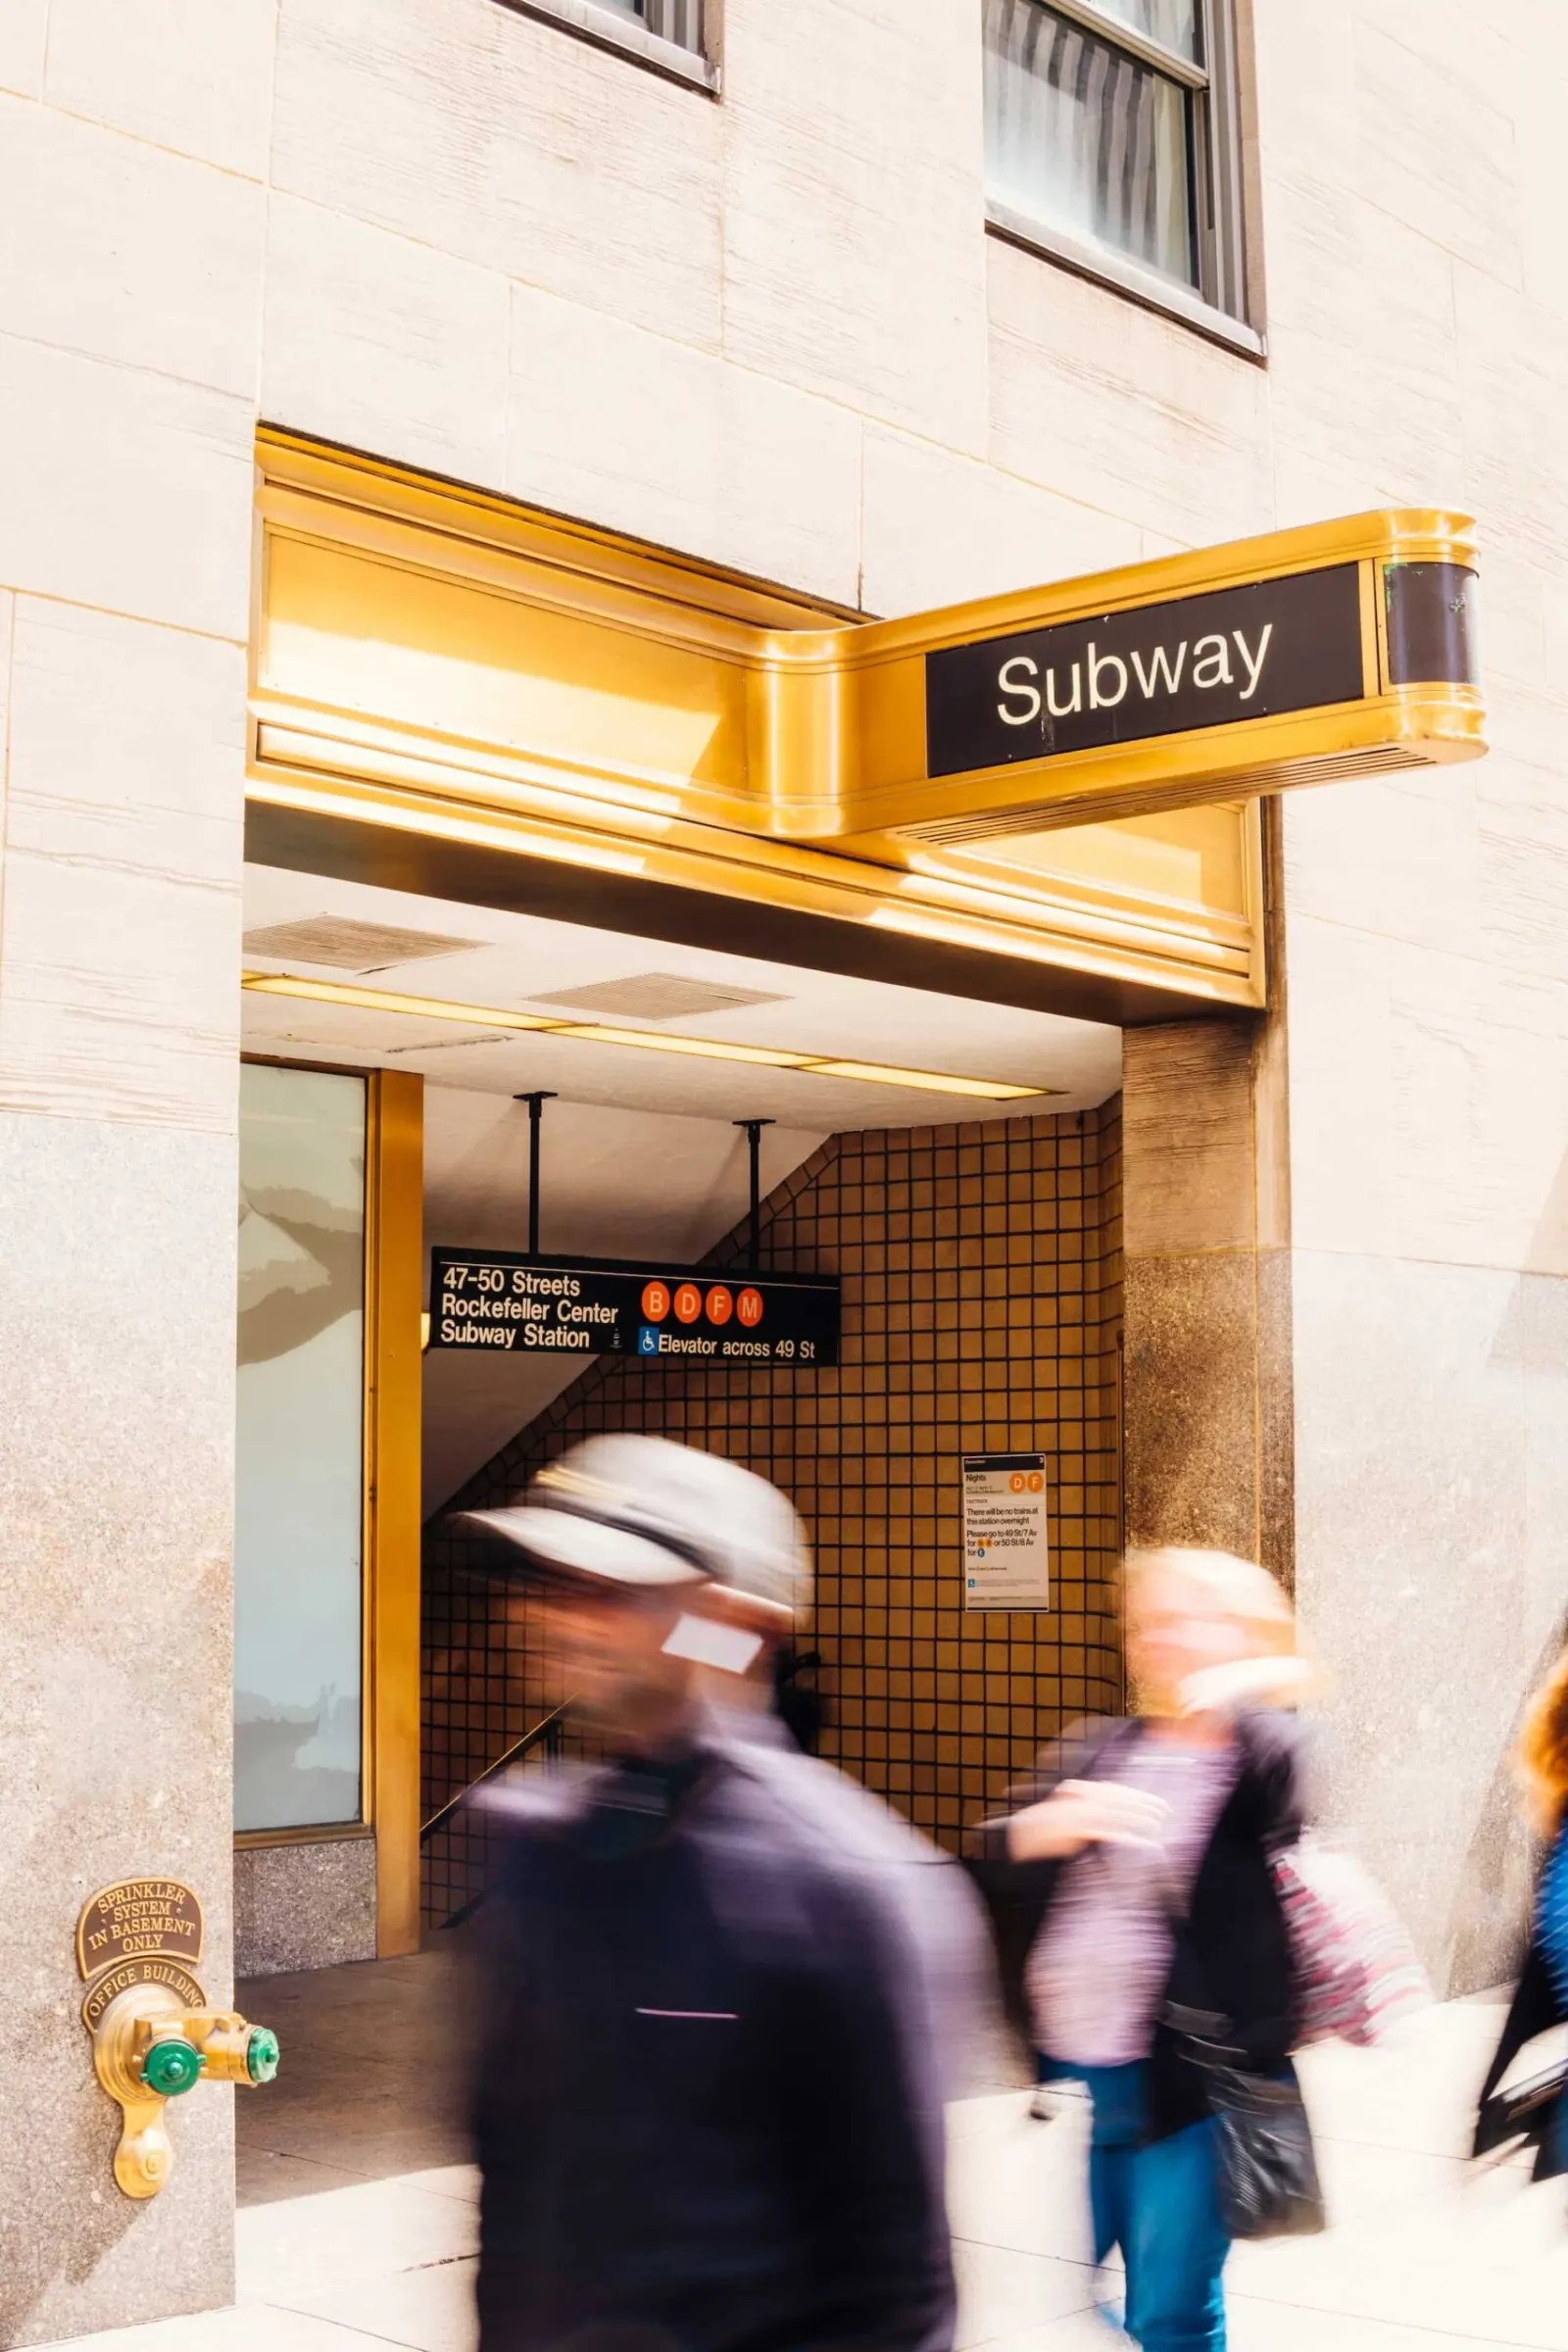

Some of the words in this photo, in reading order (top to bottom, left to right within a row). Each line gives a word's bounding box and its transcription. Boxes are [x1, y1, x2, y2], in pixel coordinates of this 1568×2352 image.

[997, 623, 1272, 725] Subway
[443, 1267, 505, 1292] 47-50
[512, 1271, 580, 1297] Streets
[442, 1294, 550, 1321] Rockefeller
[557, 1299, 619, 1324] Center
[649, 1291, 663, 1313] B
[681, 1293, 697, 1314] D
[713, 1295, 725, 1317] F
[742, 1297, 758, 1318] M
[441, 1319, 516, 1348] Subway
[523, 1323, 590, 1348] Station
[658, 1334, 717, 1354] Elevator
[722, 1341, 770, 1356] across
[775, 1340, 795, 1358] 49
[800, 1342, 815, 1358] St
[965, 1474, 987, 1483] Nights
[97, 1884, 187, 1914] SPRINKLER
[113, 1900, 172, 1922] SYSTEM
[88, 1929, 109, 1950] IN
[110, 1918, 196, 1940] BASEMENT
[122, 1934, 165, 1953] ONLY
[88, 1968, 137, 2017] OFFICE
